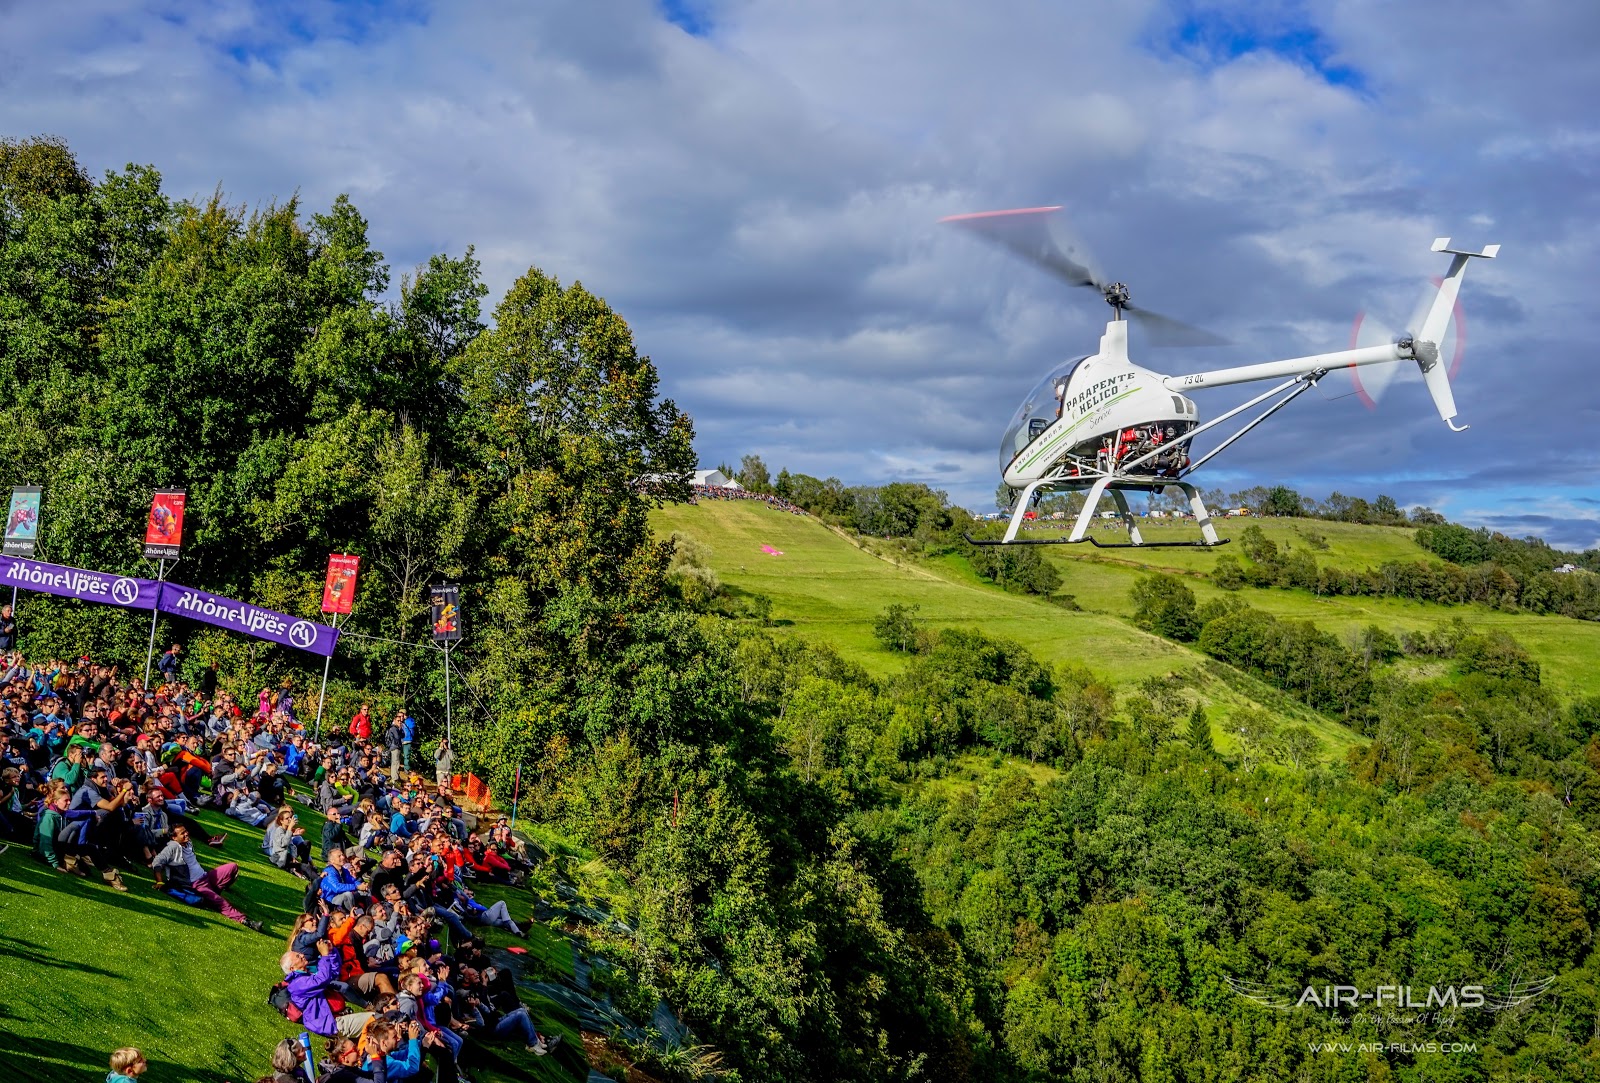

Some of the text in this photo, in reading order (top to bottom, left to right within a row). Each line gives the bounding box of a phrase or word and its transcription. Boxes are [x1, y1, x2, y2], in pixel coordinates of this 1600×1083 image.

[1066, 372, 1136, 411] PARAPENTE
[1080, 385, 1119, 414] HELICO
[79, 573, 102, 581] Région
[255, 610, 280, 622] Région
